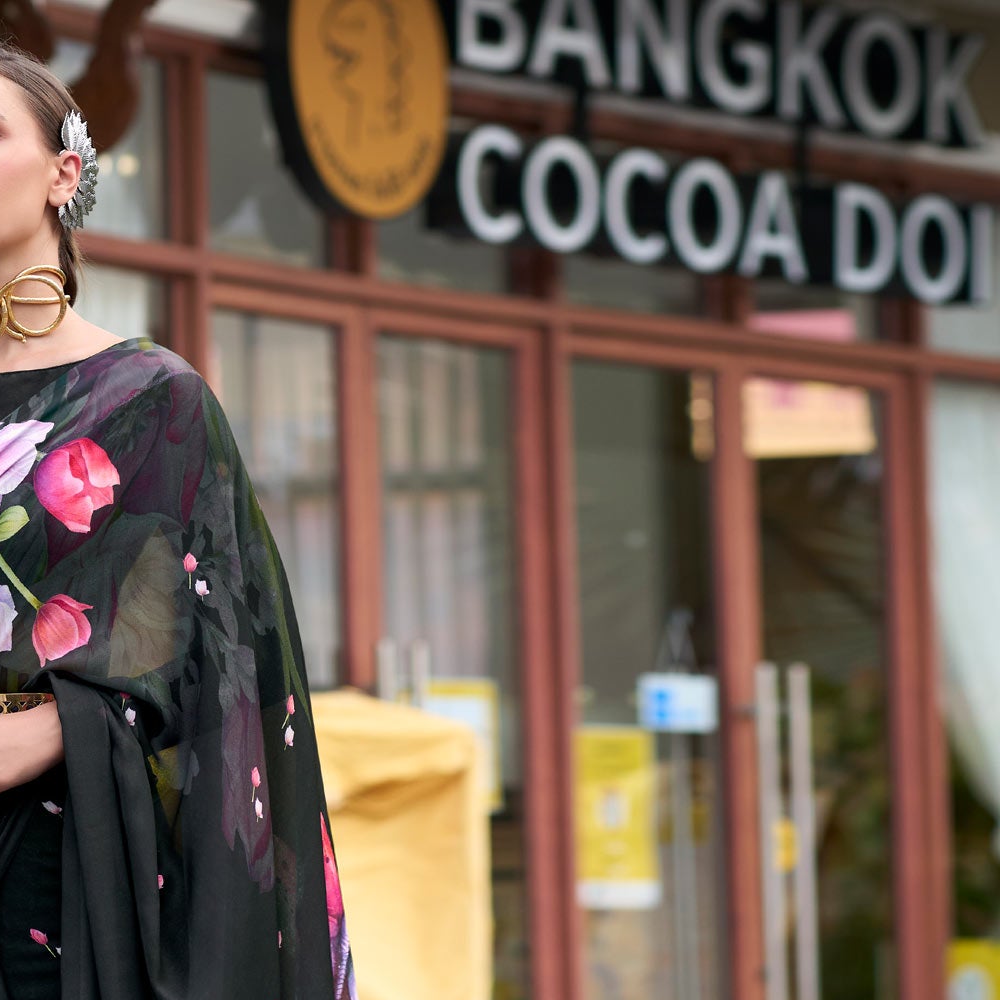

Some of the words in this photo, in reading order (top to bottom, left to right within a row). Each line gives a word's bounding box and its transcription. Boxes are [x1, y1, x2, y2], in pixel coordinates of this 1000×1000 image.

[456, 0, 984, 147] BANGKOK
[458, 124, 806, 281] COCOA
[834, 182, 993, 303] DOI
